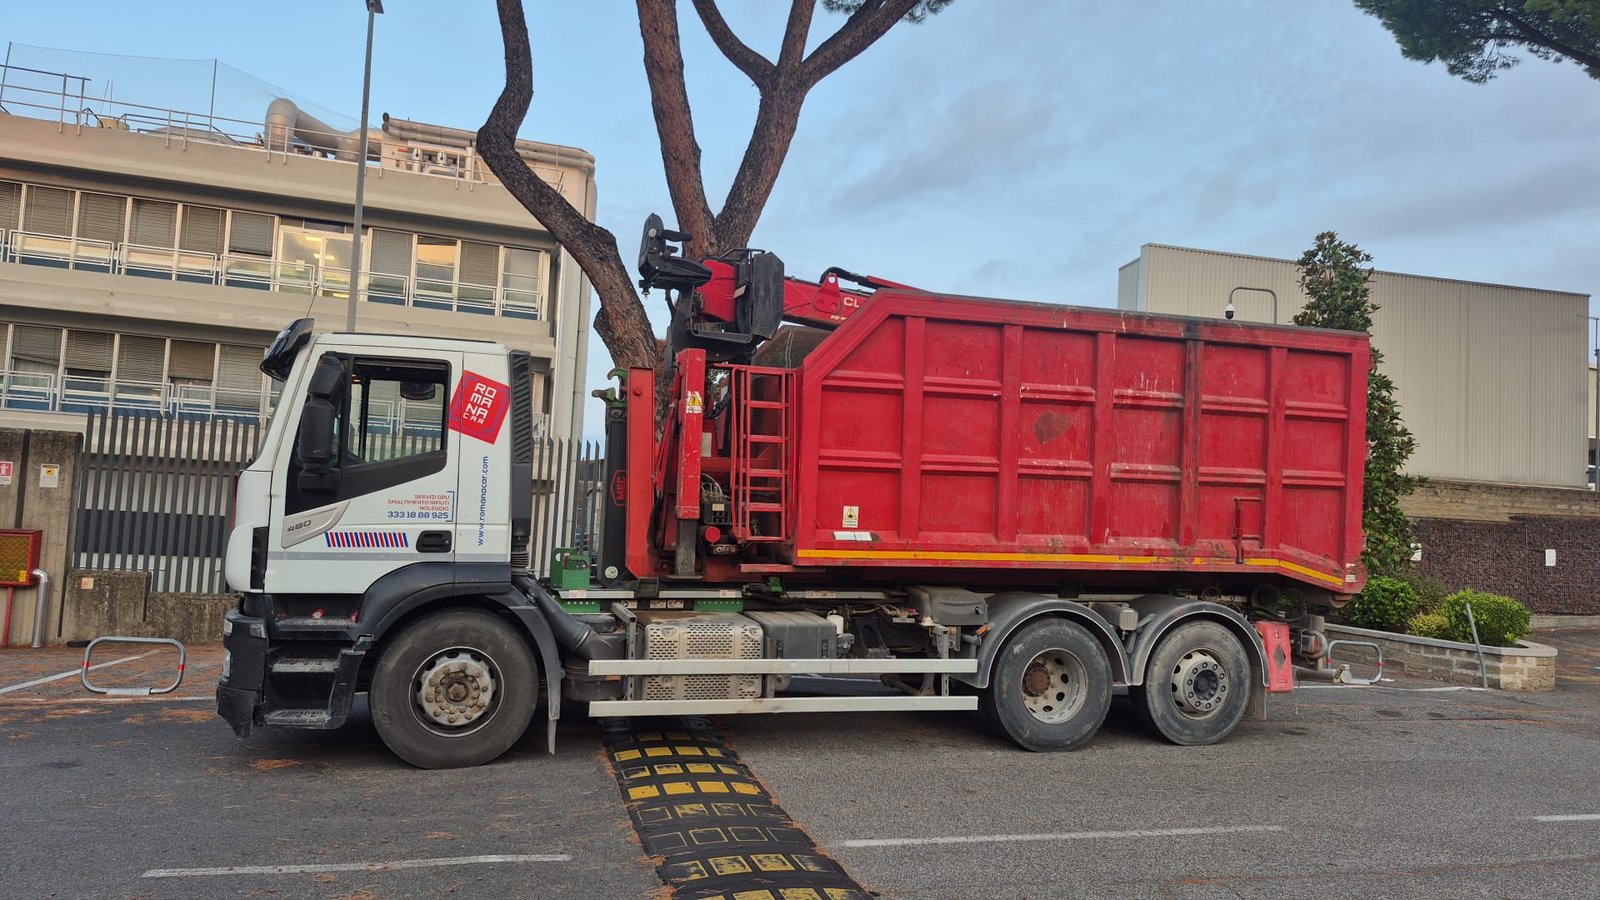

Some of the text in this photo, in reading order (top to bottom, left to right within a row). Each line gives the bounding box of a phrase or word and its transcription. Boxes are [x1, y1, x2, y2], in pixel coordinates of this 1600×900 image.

[474, 382, 497, 399] RO
[463, 412, 485, 425] CAR
[465, 403, 488, 419] NA
[478, 456, 489, 546] www.romanacar.com
[418, 511, 430, 519] 88
[431, 511, 449, 519] 925
